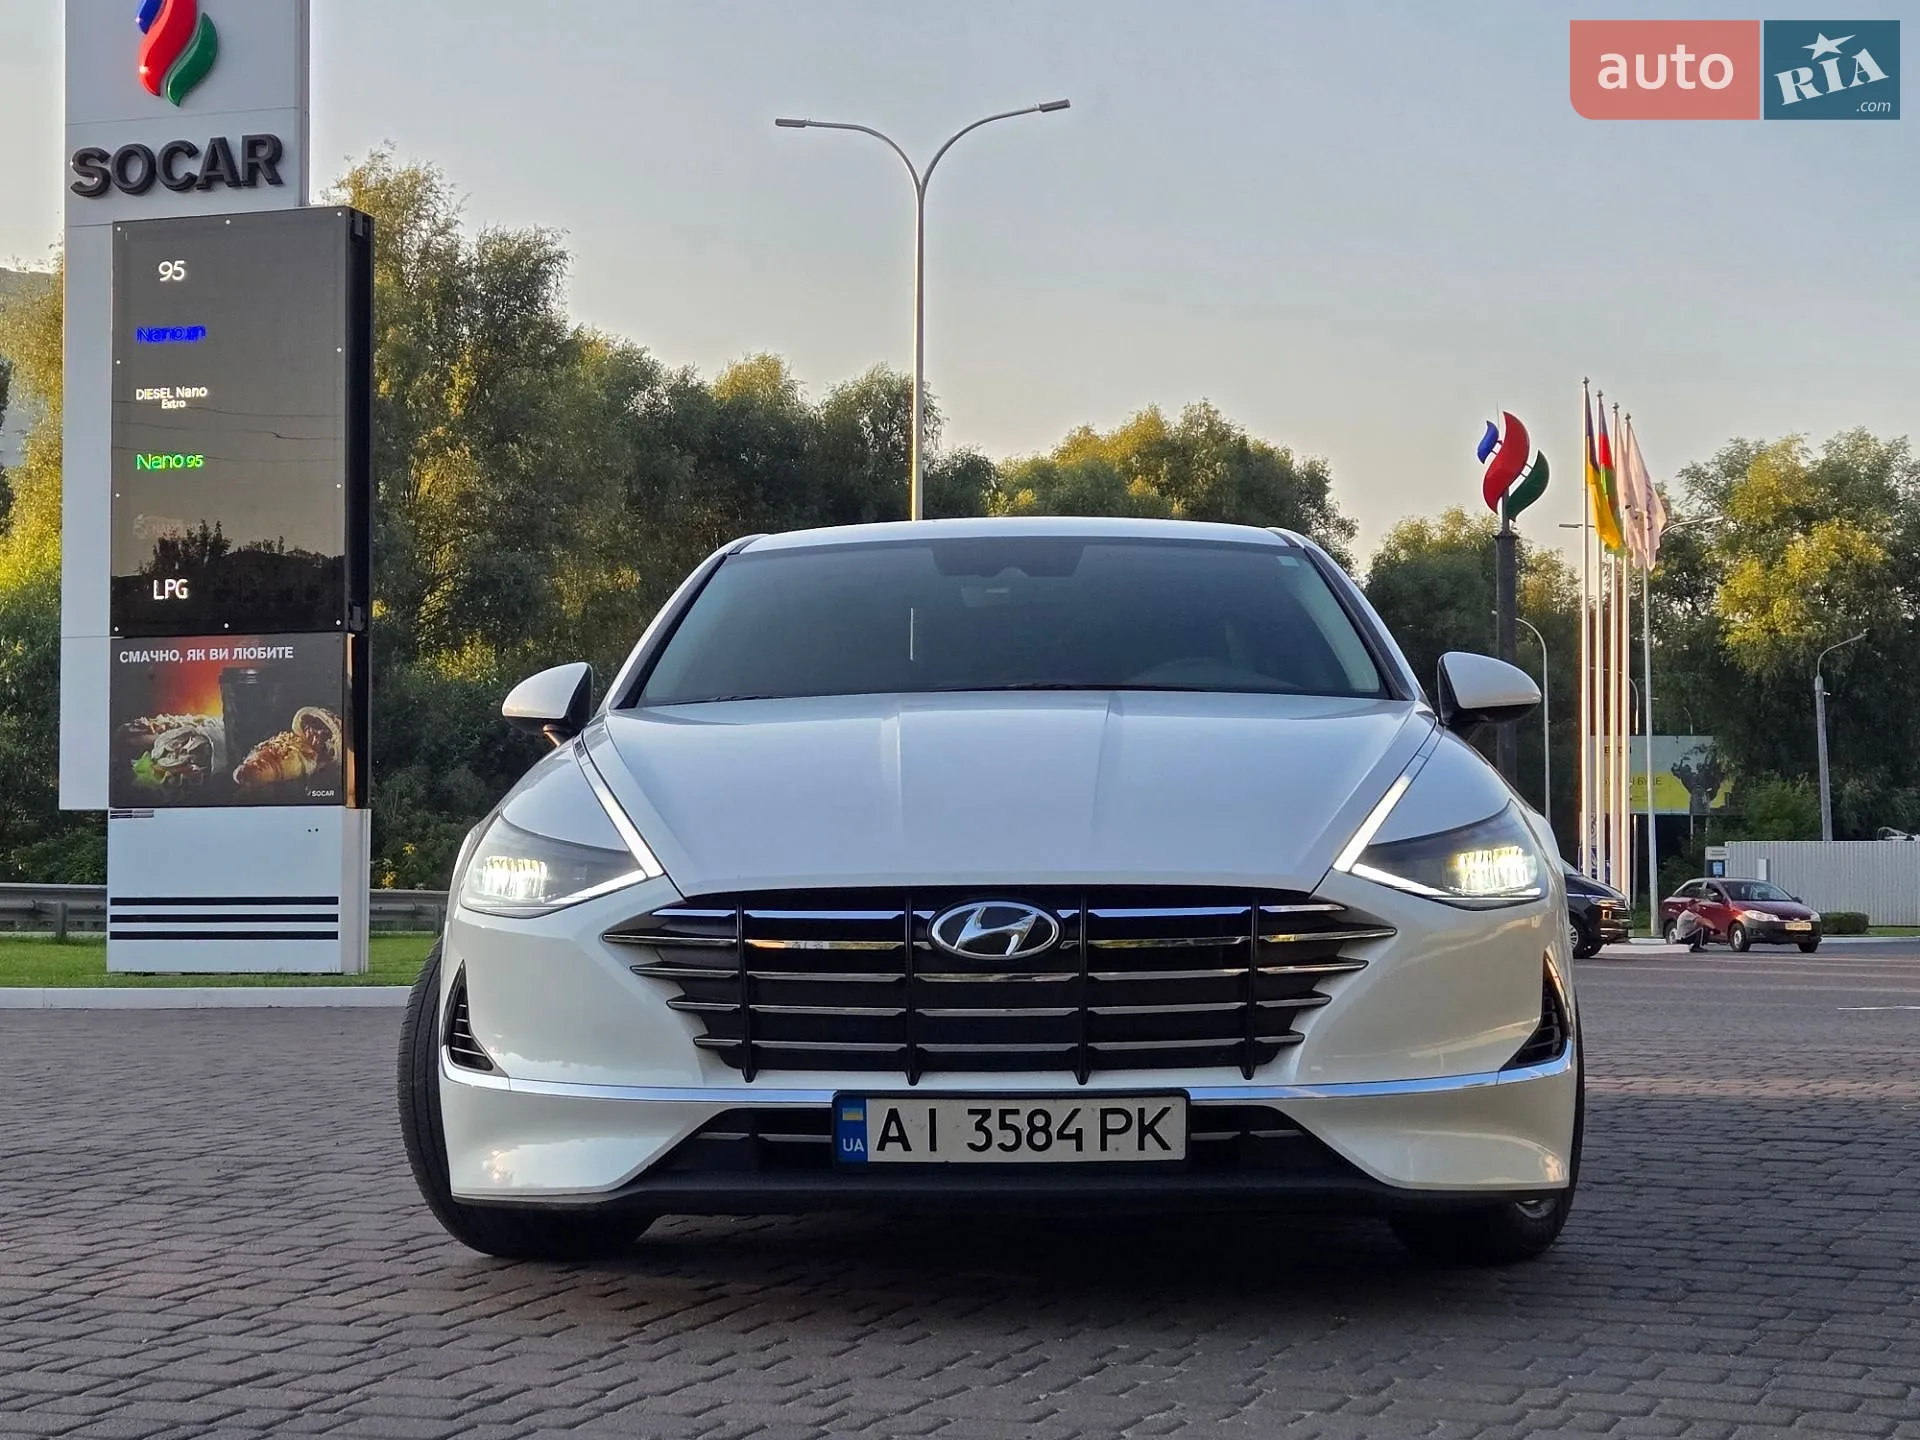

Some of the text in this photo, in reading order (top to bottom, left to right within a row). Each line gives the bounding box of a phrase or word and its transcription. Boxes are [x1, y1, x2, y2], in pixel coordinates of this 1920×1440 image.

[70, 134, 284, 197] SOCAR
[158, 260, 185, 281] 95
[136, 386, 208, 400] DIESEL Nano
[136, 453, 204, 470] Nano 95
[153, 579, 188, 600] LPG
[119, 646, 294, 664] СМАЧНО, ЯК ВИ ЛЮБИТЕ
[876, 1106, 1172, 1153] AI 3584 PK
[842, 1138, 865, 1152] UA
